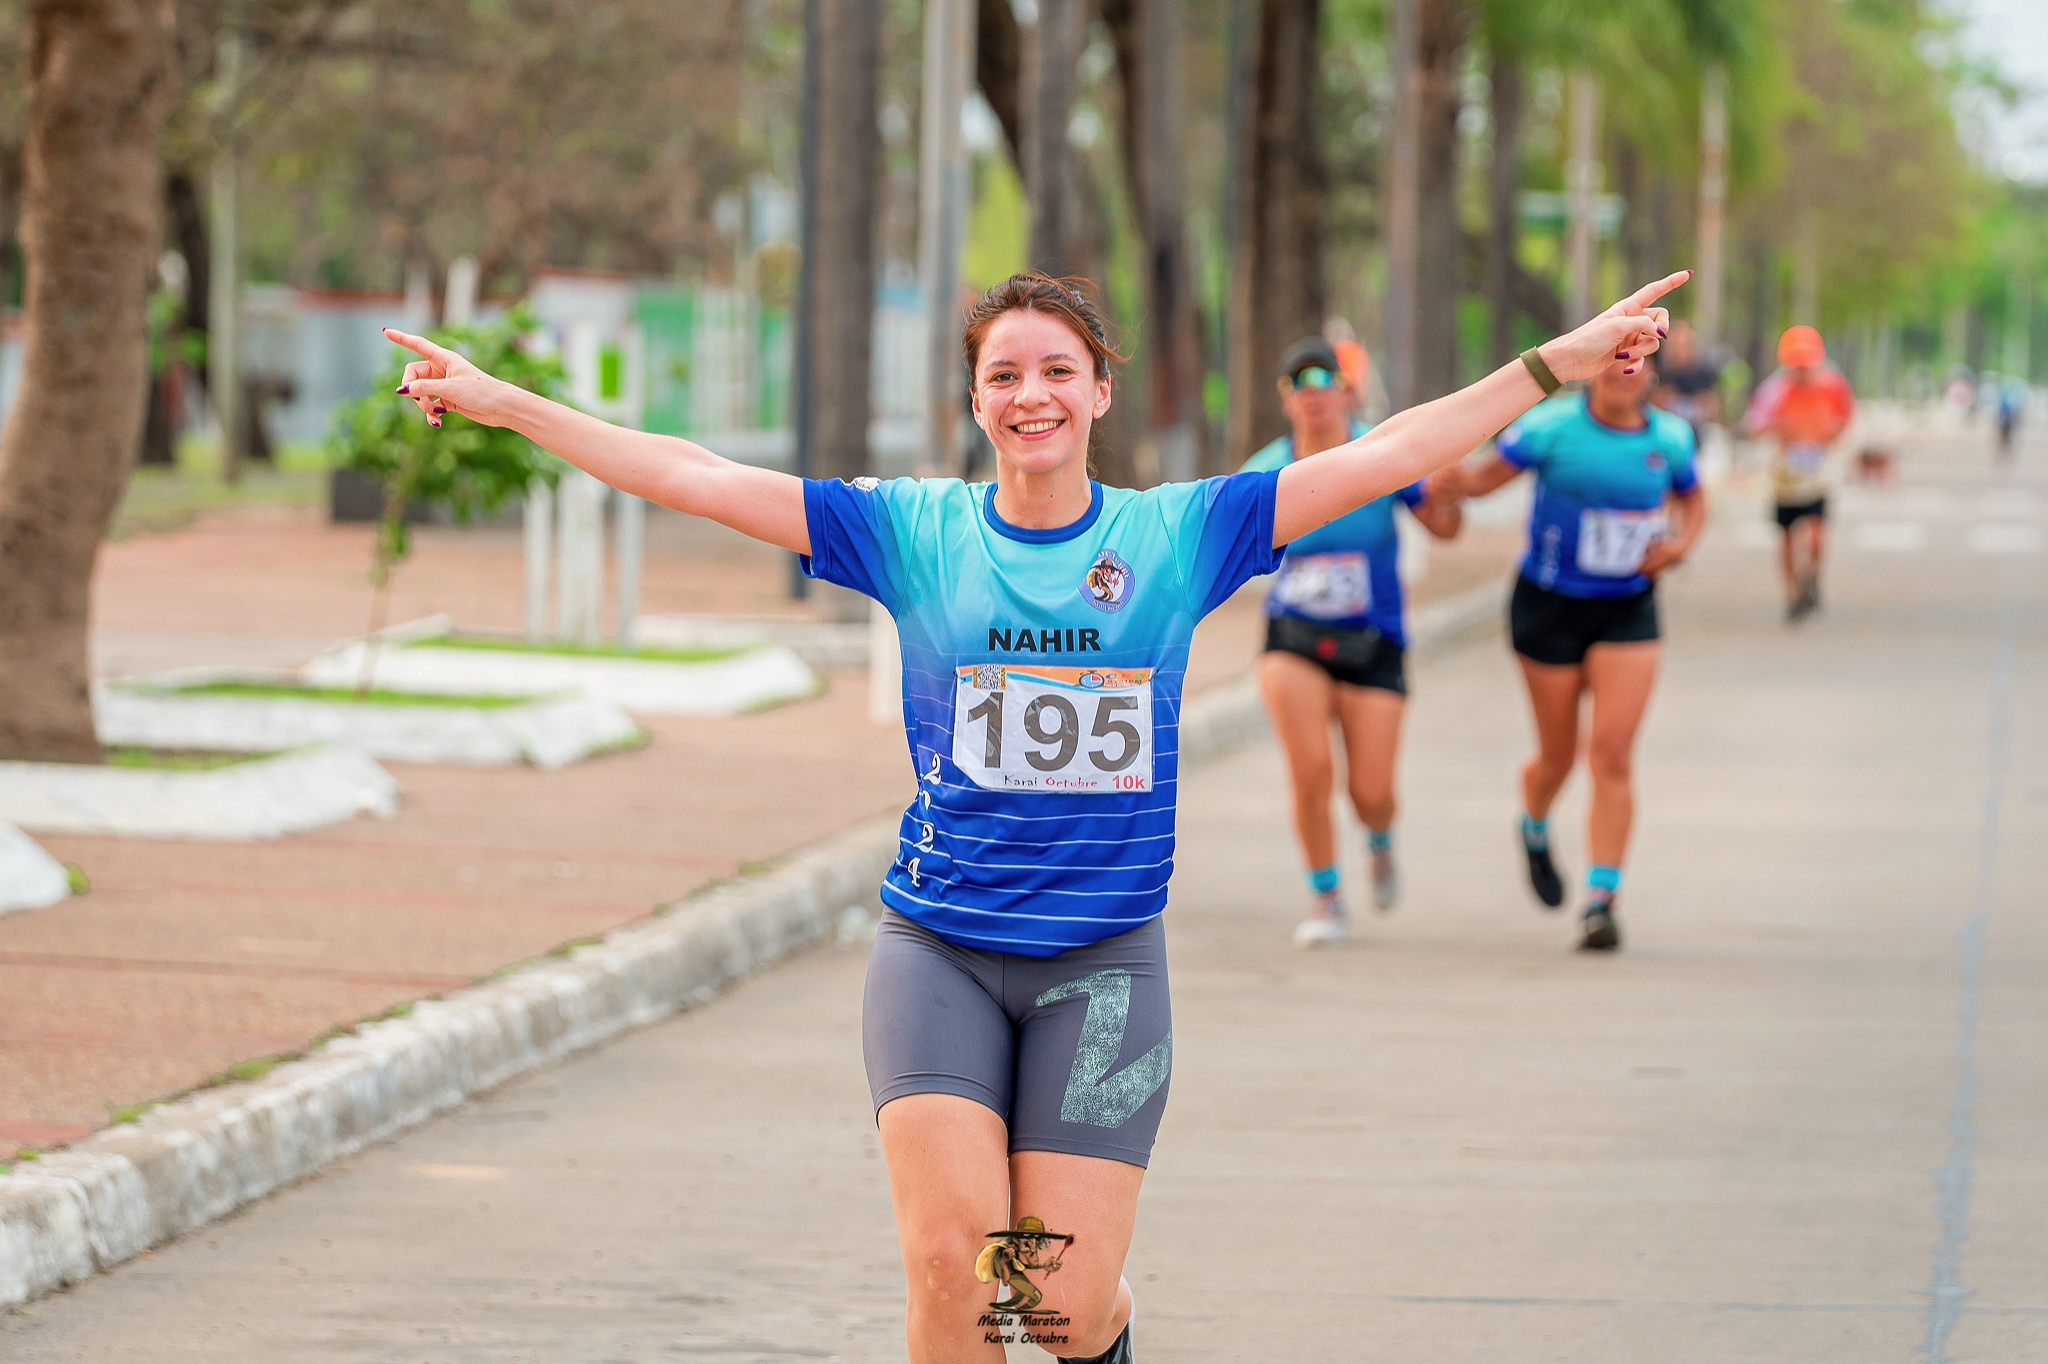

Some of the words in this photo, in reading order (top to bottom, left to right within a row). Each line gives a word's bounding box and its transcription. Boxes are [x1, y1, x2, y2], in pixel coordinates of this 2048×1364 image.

[988, 628, 1102, 652] NAHIR
[967, 692, 1141, 772] 195
[1004, 775, 1038, 786] Karai
[1045, 776, 1098, 788] Octubre
[1112, 774, 1146, 790] 10k
